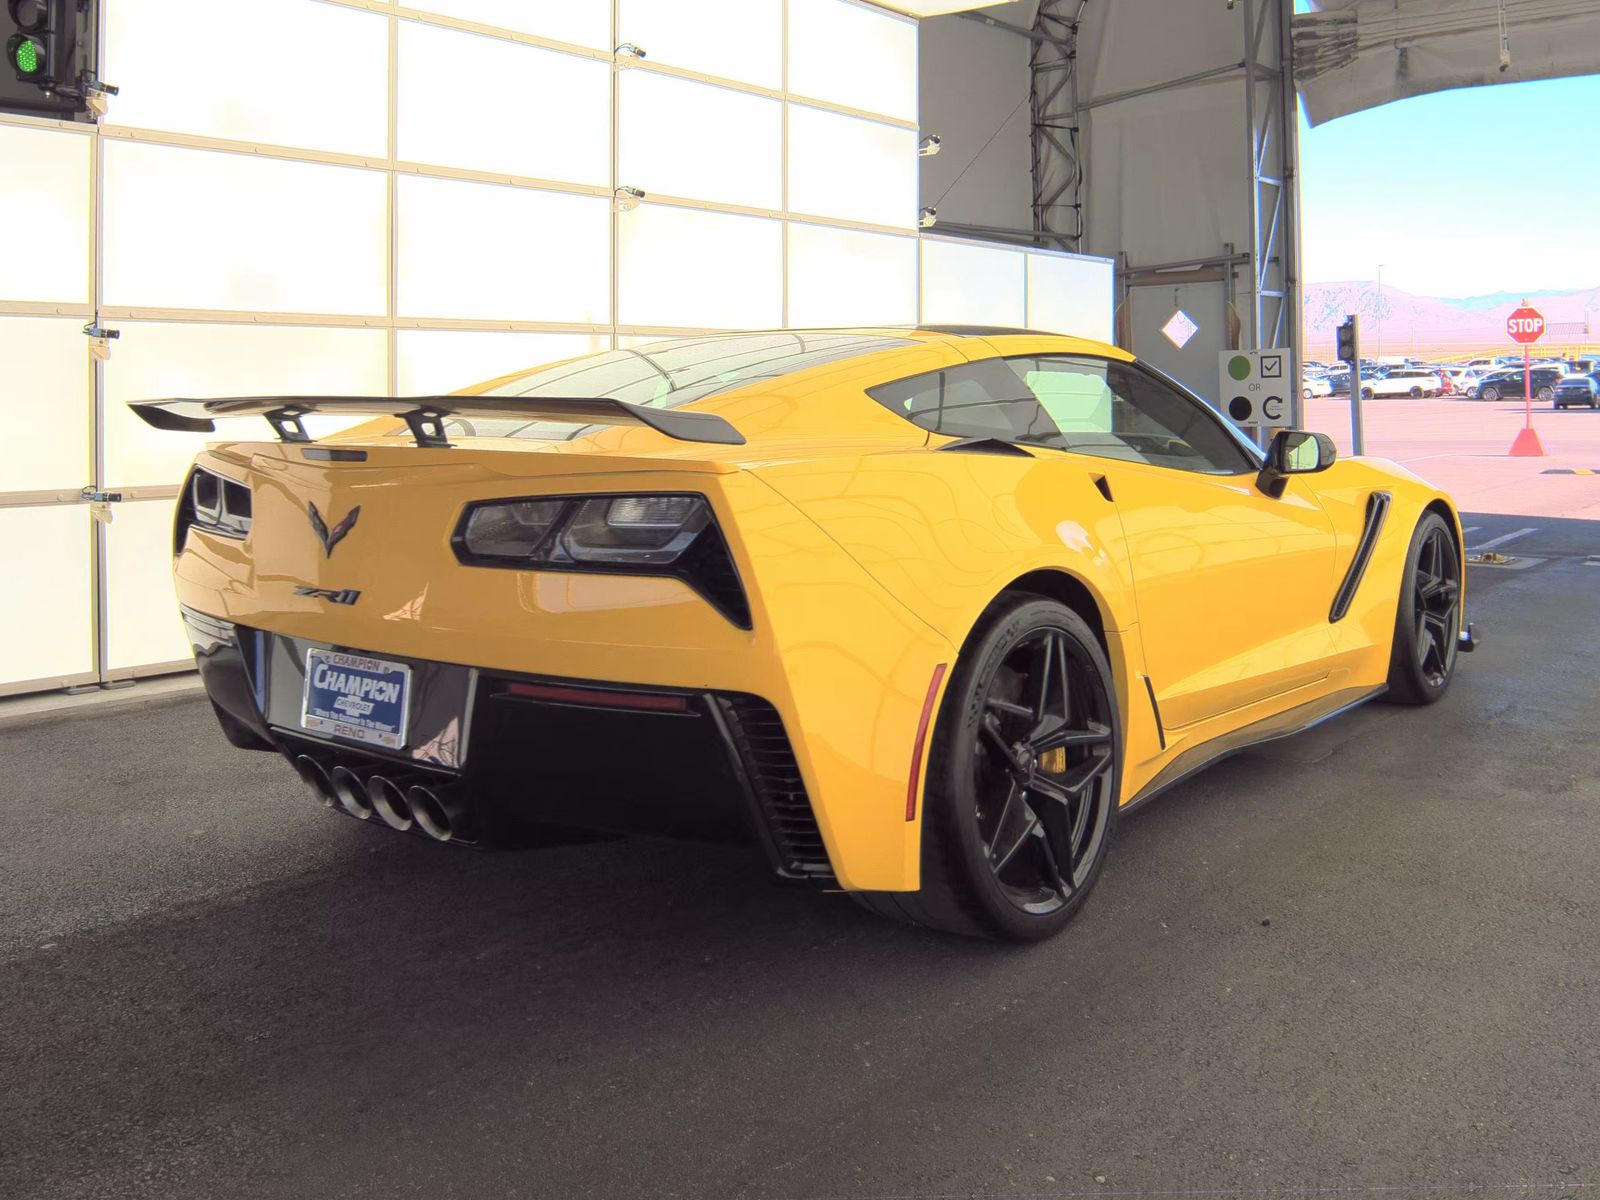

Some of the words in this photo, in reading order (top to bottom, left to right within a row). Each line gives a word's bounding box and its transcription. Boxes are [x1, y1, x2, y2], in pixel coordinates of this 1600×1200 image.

[1508, 318, 1543, 333] STOP
[1248, 383, 1261, 392] OR
[333, 654, 379, 671] CHAMPION
[313, 663, 400, 704] CHAMPION
[337, 699, 371, 712] CHEVROLET
[334, 724, 365, 739] RENO
